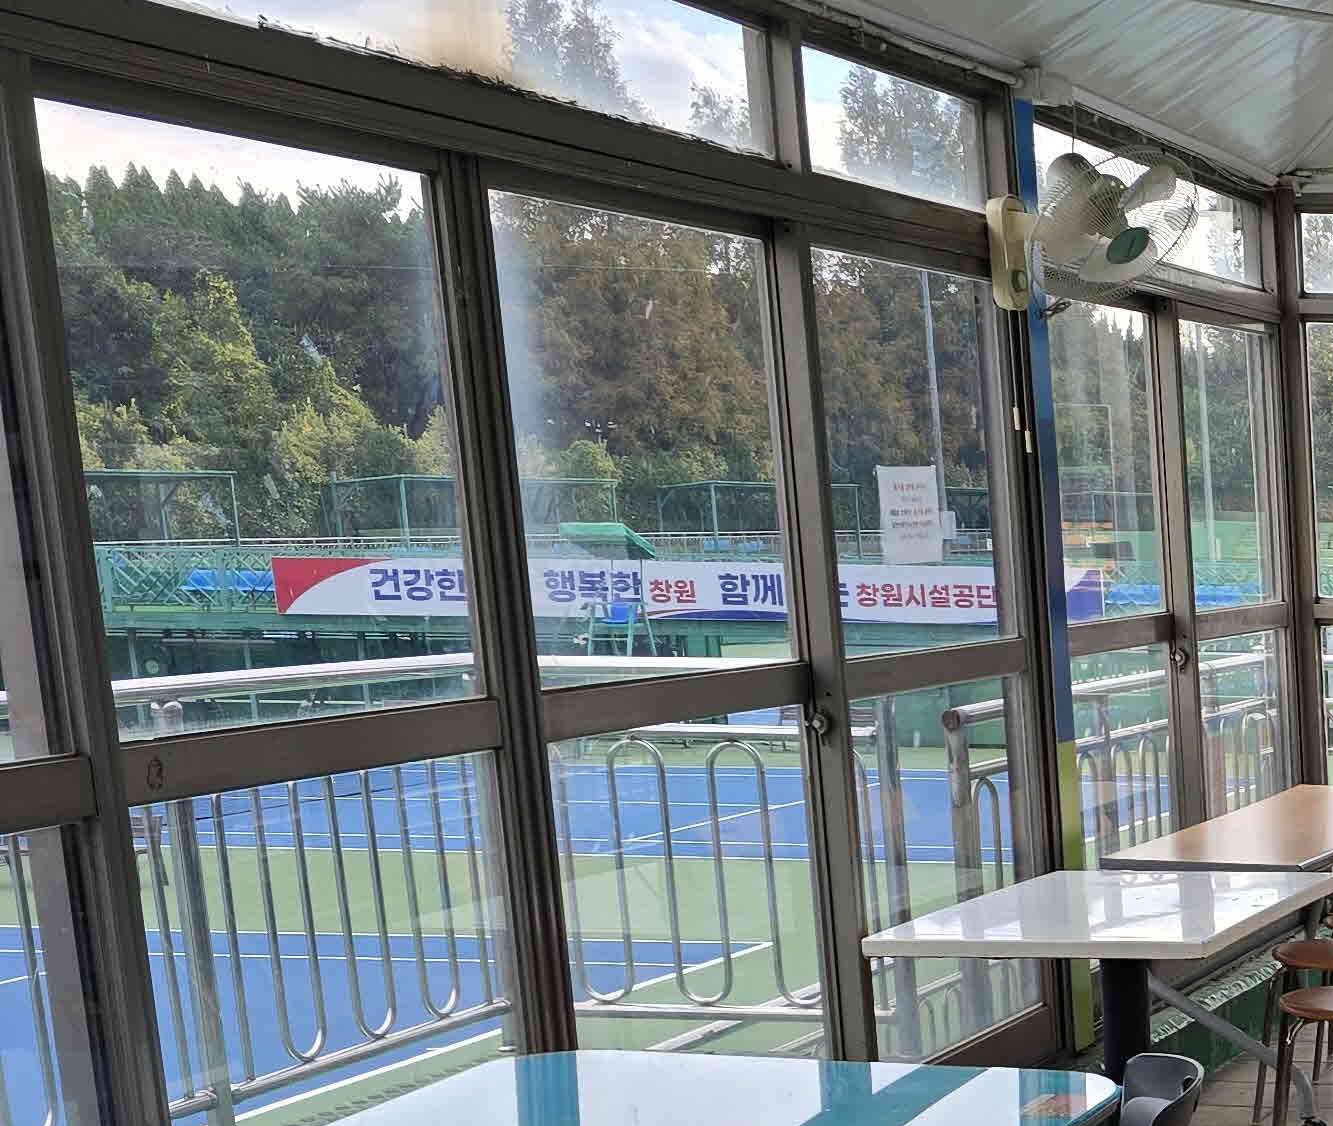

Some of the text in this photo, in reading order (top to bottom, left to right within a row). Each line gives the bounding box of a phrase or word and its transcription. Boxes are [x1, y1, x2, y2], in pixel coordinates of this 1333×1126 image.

[368, 568, 467, 602] 건강한
[543, 568, 642, 603] 행복한
[649, 579, 697, 604] 창원
[855, 582, 999, 609] 창원시설공단
